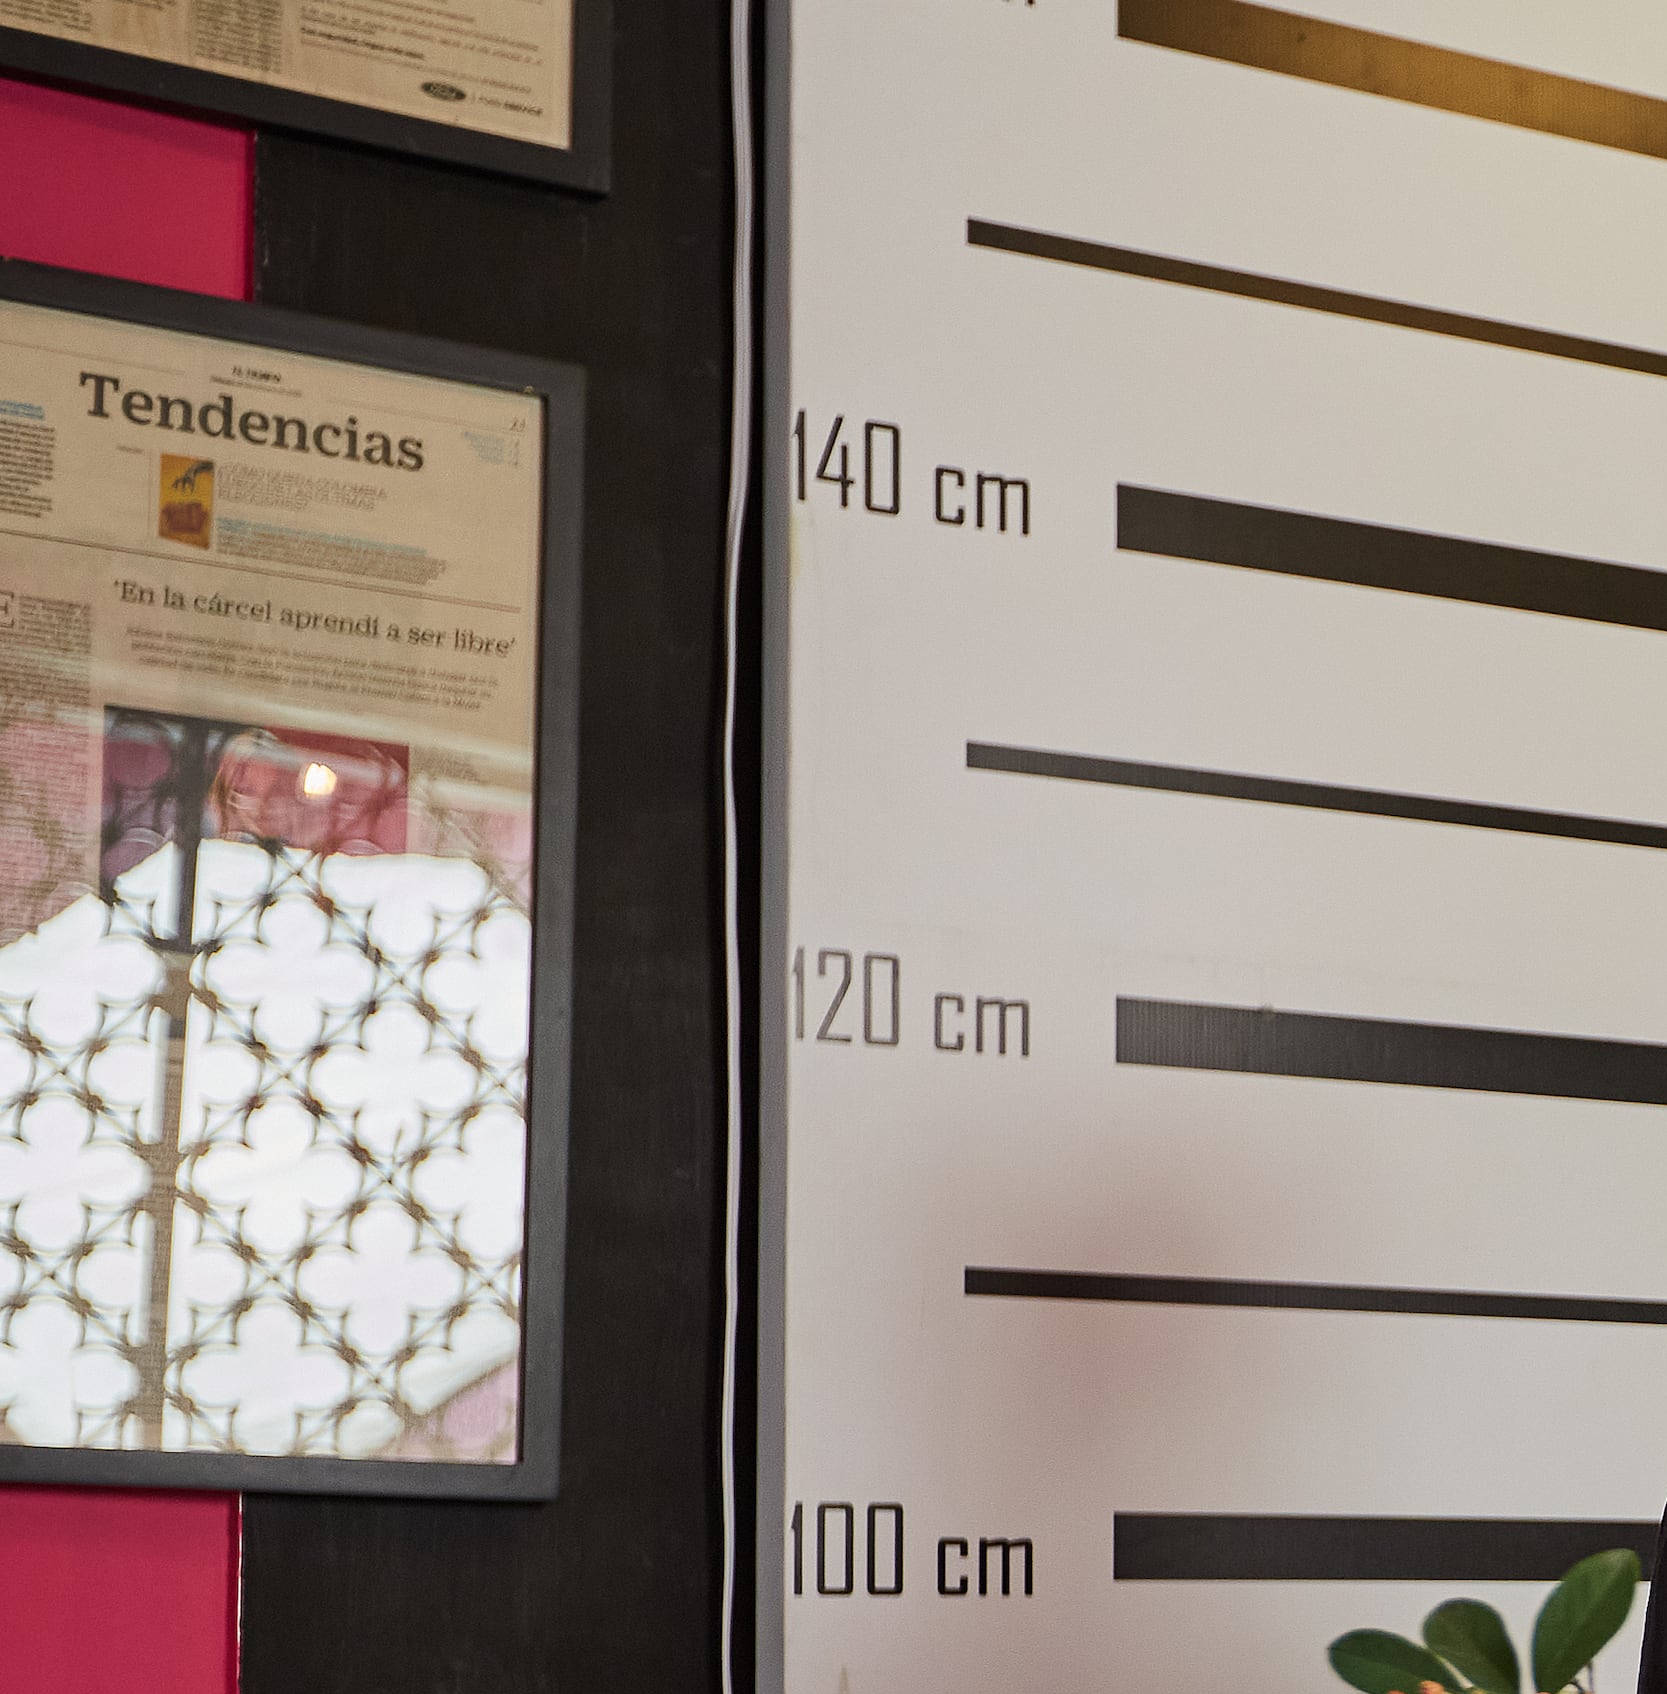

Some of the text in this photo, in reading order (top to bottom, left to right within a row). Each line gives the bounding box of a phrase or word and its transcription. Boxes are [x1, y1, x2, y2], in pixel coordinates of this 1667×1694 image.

[79, 370, 425, 472] Tendencias
[793, 408, 1031, 536] 140 cm
[163, 584, 186, 611] la
[193, 591, 272, 623] cárcel
[280, 606, 380, 640] aprendí
[386, 622, 401, 643] a
[407, 625, 447, 649] ser
[792, 945, 1031, 1057] 120 cm
[790, 1500, 1034, 1597] 100 cm
